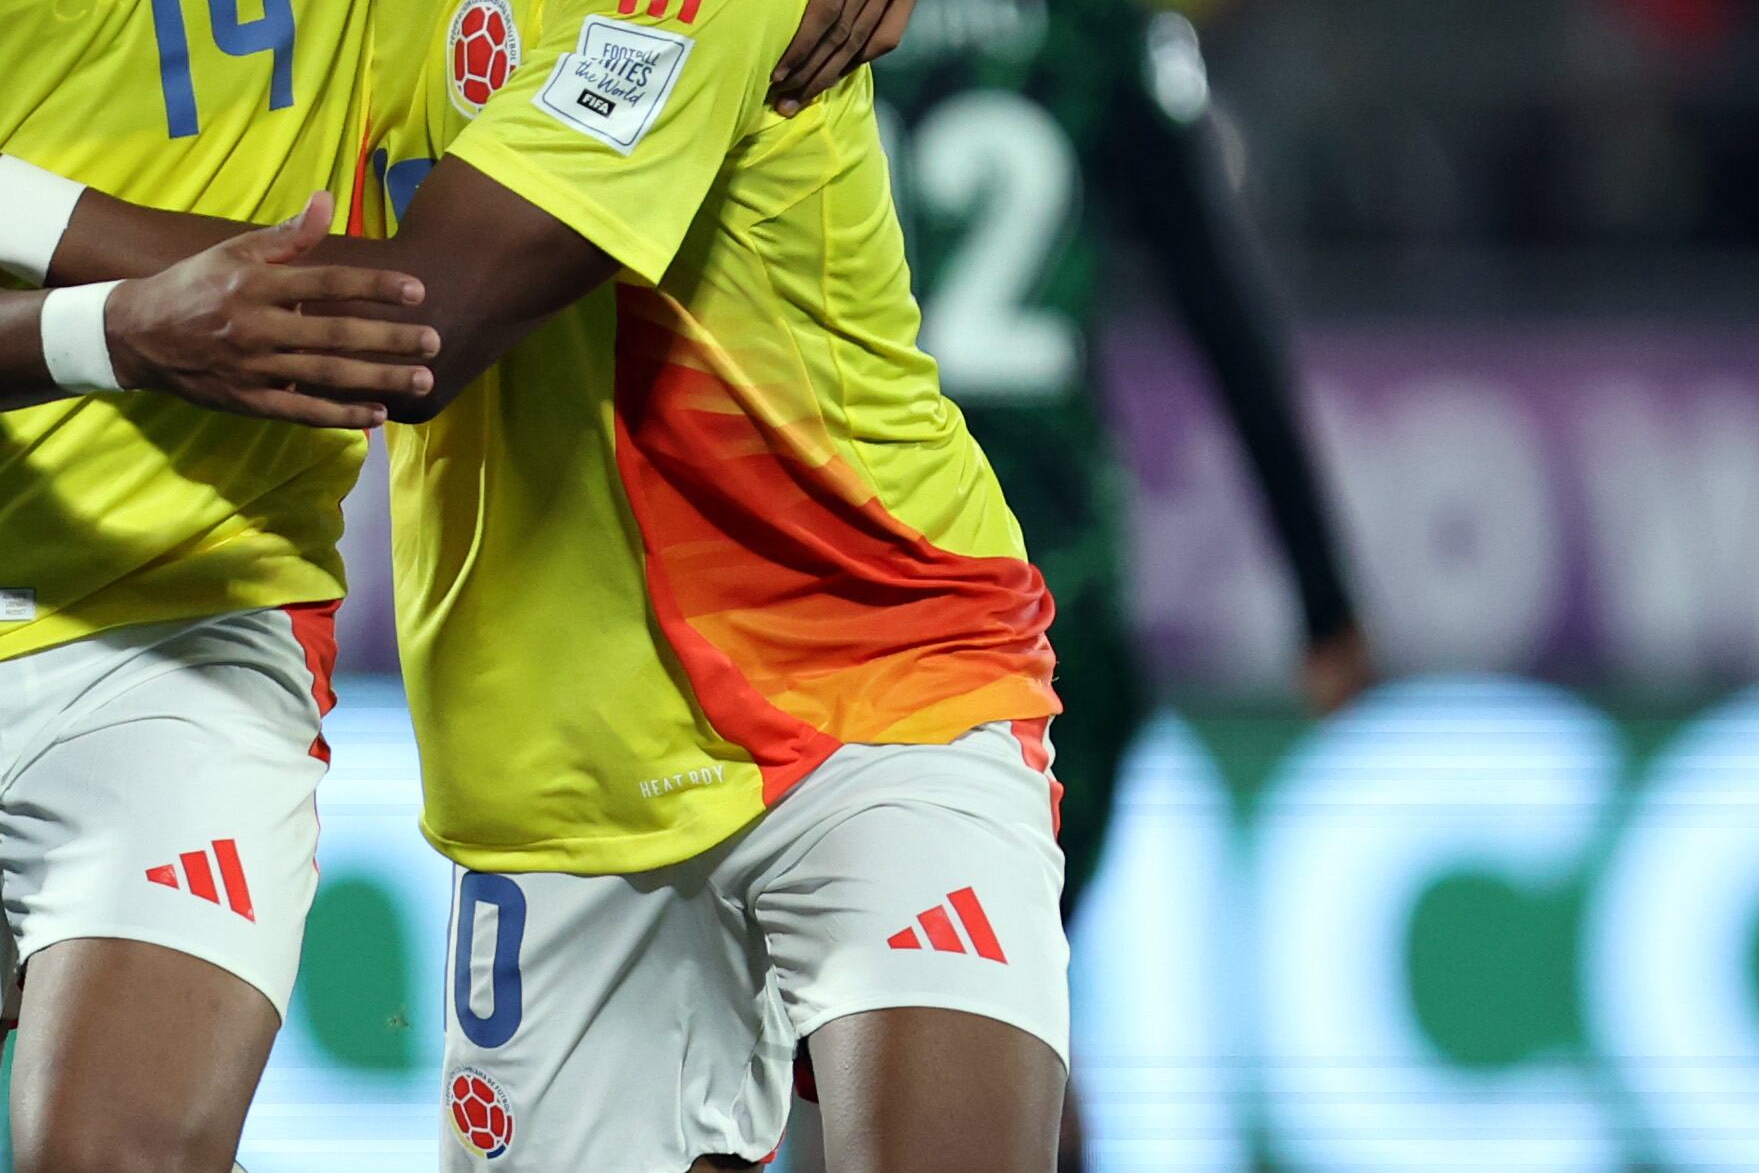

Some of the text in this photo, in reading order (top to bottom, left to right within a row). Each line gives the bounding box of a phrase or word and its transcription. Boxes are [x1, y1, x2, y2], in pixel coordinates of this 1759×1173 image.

[575, 60, 646, 107] the World
[582, 93, 610, 114] FIFA
